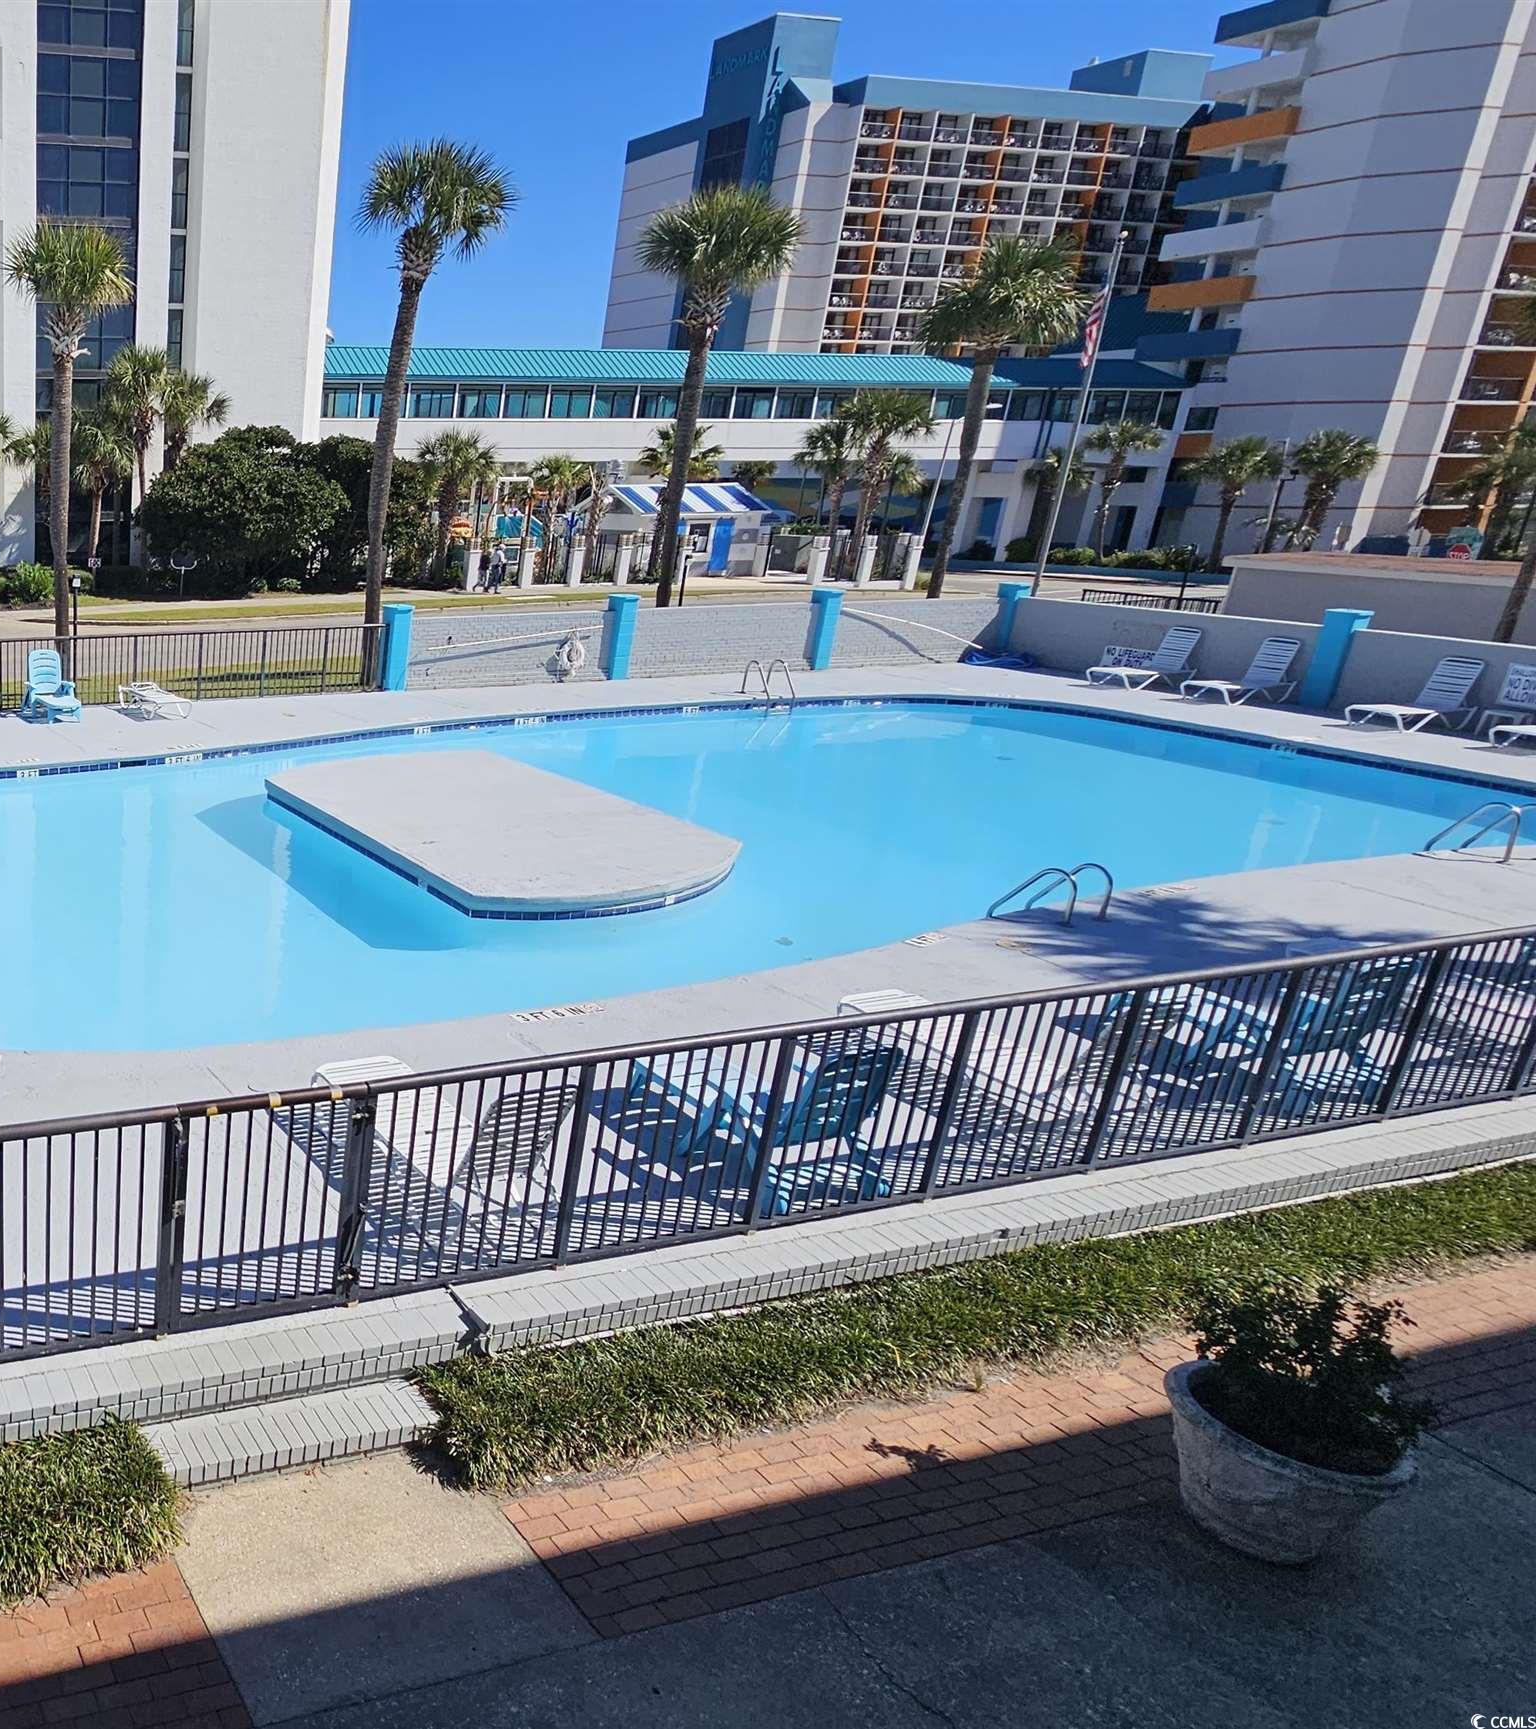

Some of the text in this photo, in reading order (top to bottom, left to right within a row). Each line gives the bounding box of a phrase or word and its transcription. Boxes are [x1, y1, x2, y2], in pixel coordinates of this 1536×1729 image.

[1449, 551, 1469, 560] STOP
[1106, 647, 1117, 656] NO
[1509, 678, 1521, 689] NO
[528, 1011, 551, 1021] FT
[564, 1006, 586, 1016] IN
